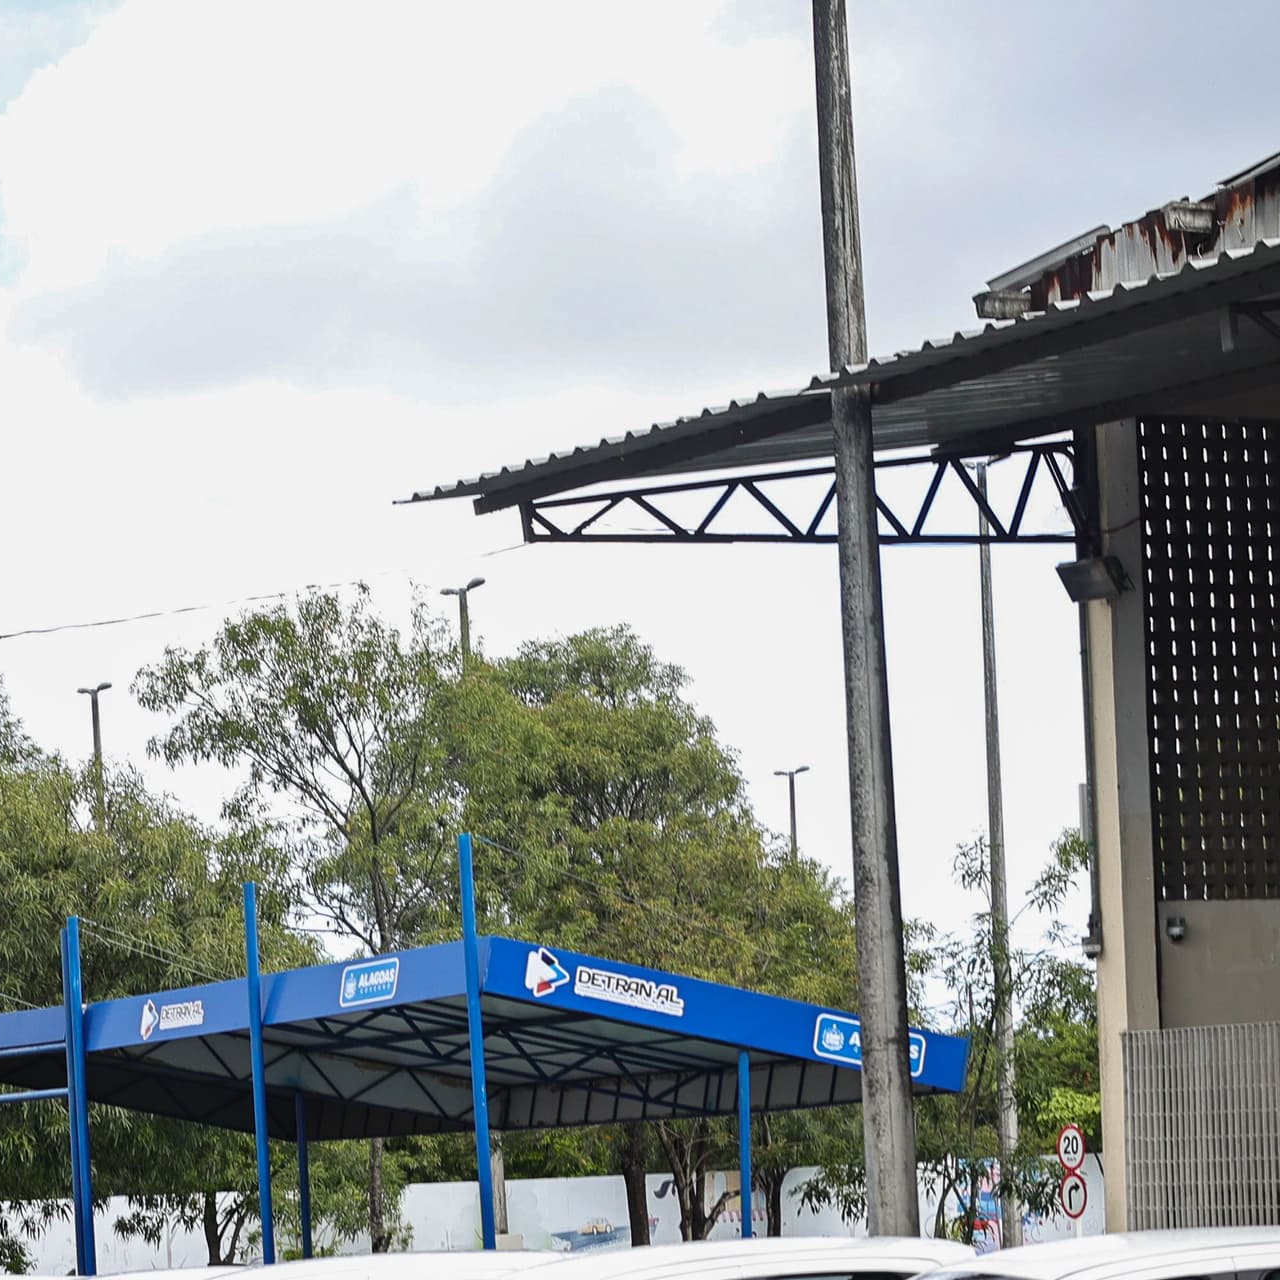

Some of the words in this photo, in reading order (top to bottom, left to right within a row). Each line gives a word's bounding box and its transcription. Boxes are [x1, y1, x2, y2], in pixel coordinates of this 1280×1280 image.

[358, 968, 395, 988] ALAGOAS
[579, 969, 652, 998] DETRAN
[1063, 1135, 1079, 1154] 20
